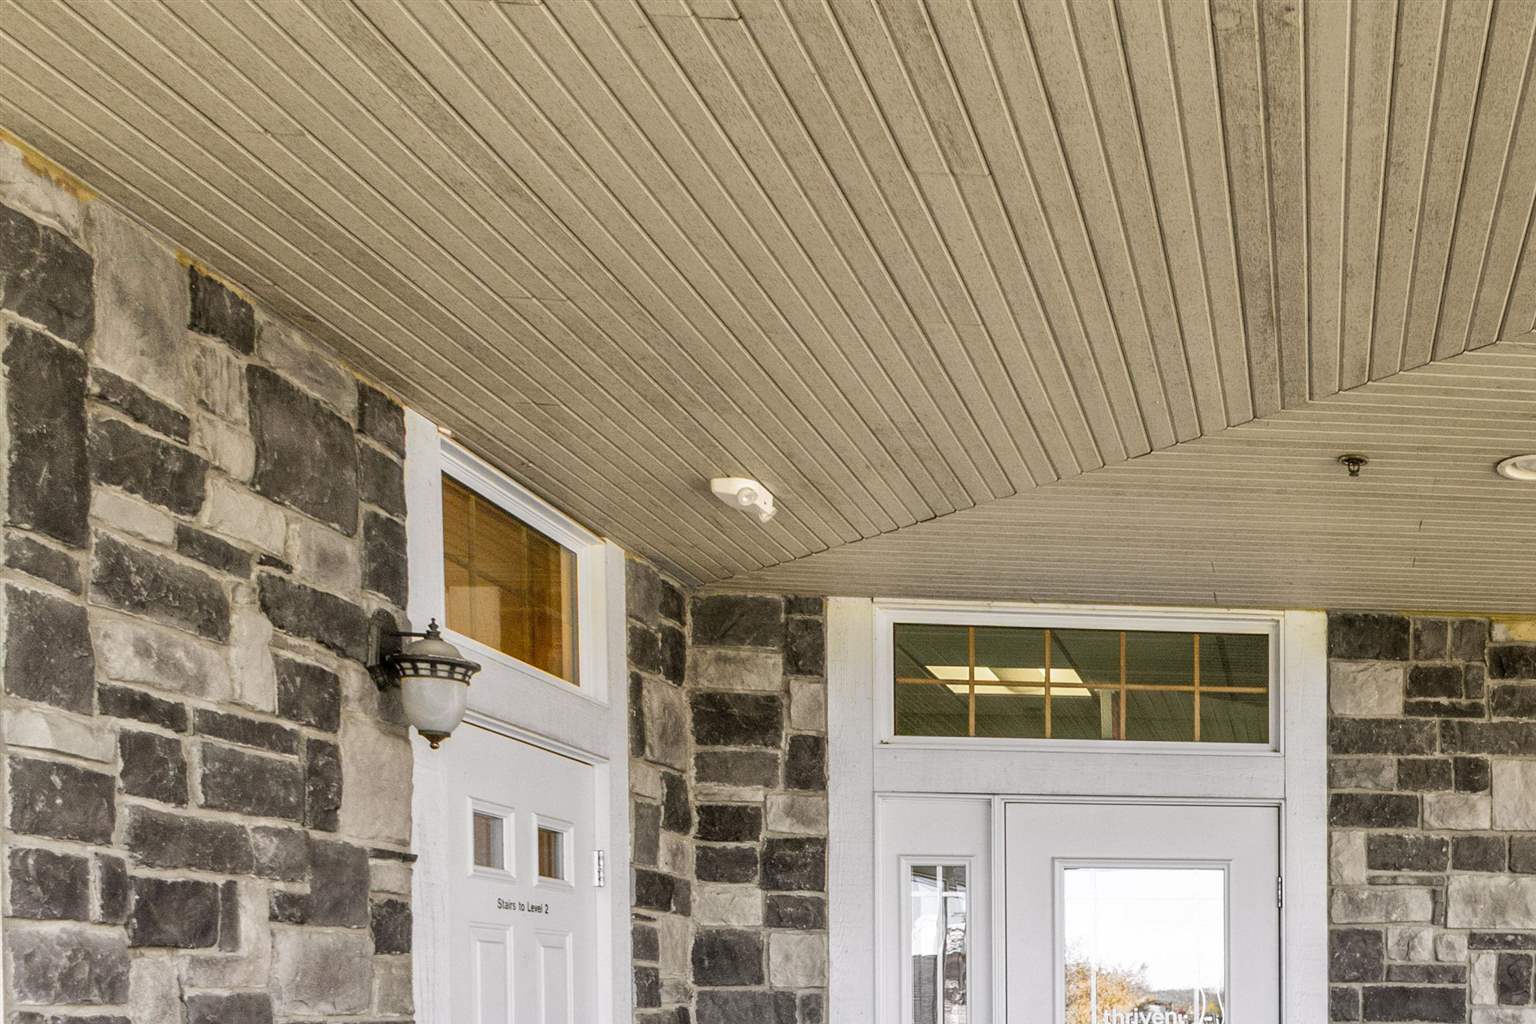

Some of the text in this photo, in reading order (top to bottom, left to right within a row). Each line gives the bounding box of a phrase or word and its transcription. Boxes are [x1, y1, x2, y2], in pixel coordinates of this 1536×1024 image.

[497, 897, 549, 914] Stairs to Level 2
